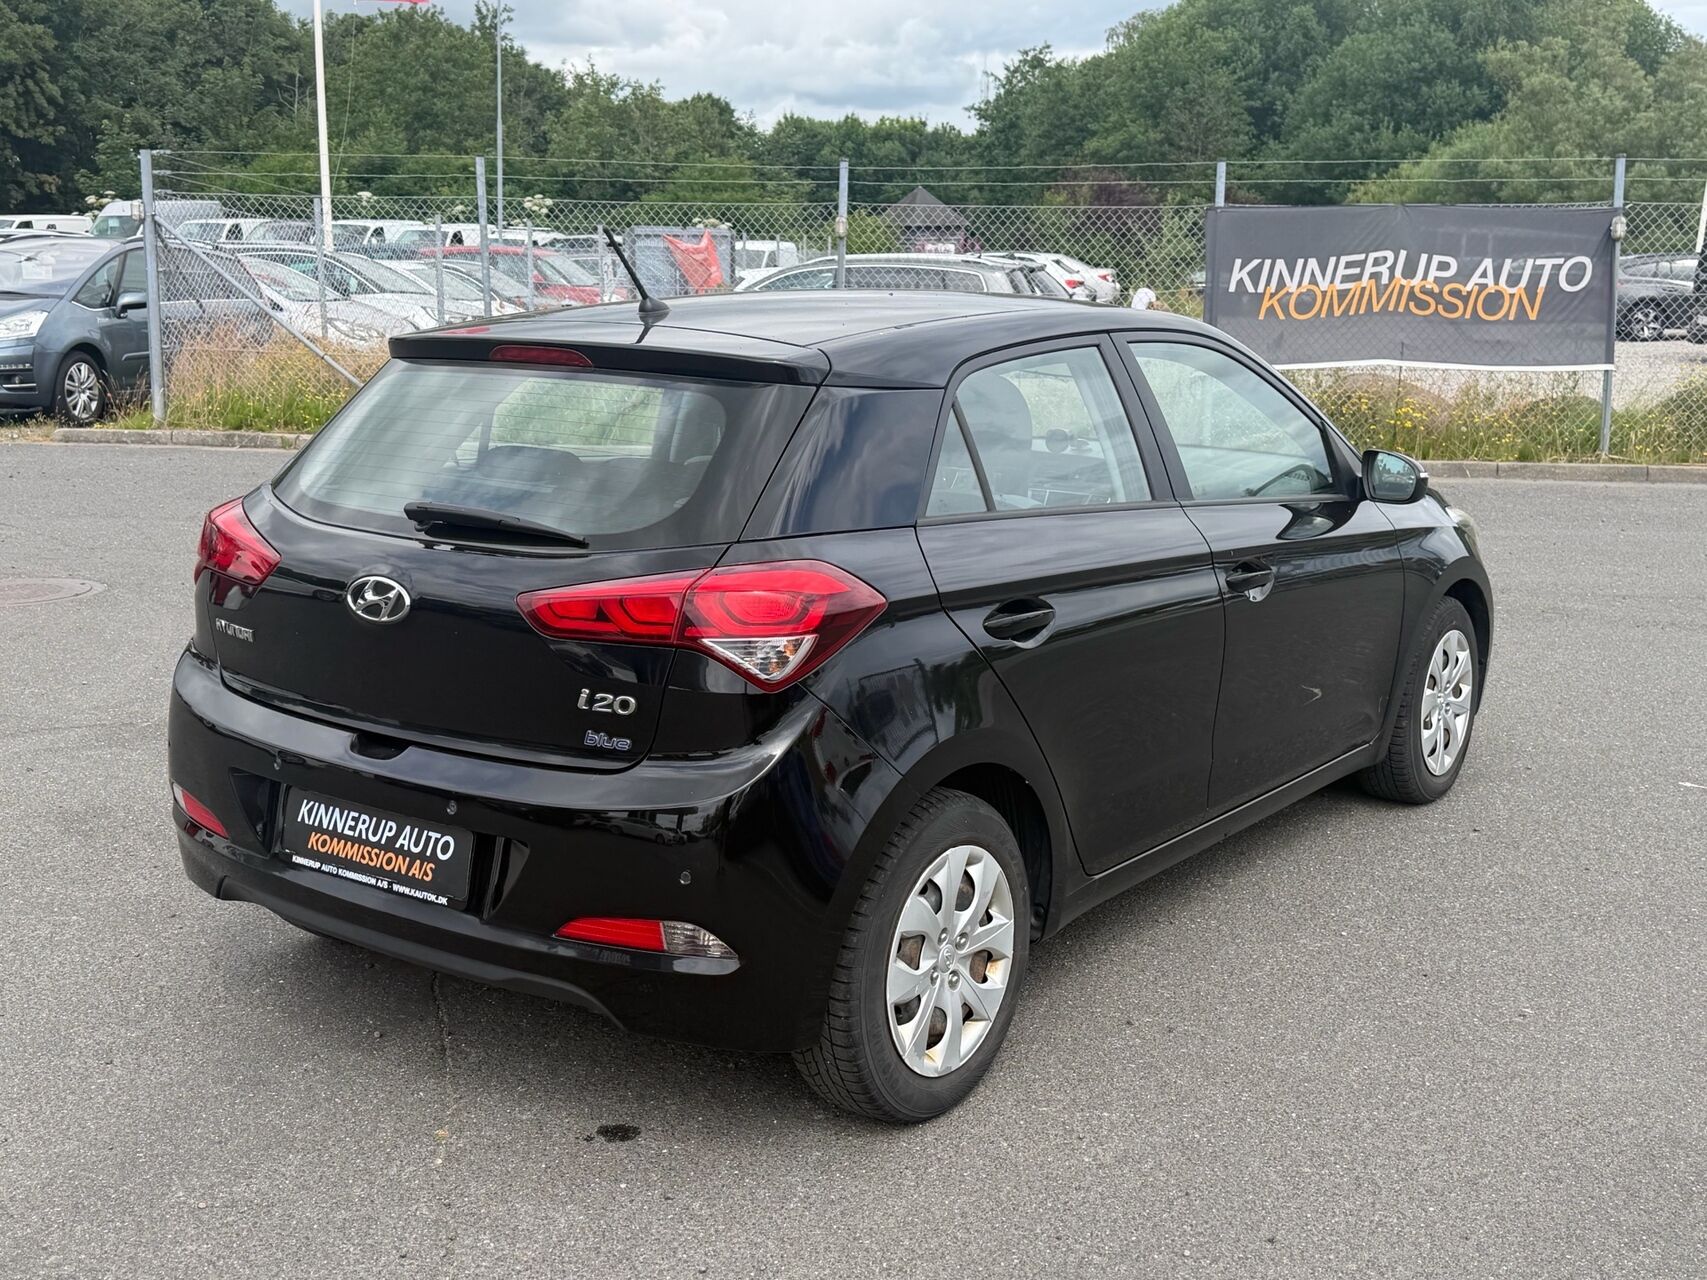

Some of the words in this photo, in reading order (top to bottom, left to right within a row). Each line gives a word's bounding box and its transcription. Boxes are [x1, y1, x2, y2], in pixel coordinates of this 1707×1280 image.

[1228, 249, 1458, 293] KINNERUP
[1465, 255, 1593, 294] AUTO
[1257, 276, 1545, 321] KOMMISSION
[577, 688, 636, 716] i20
[583, 729, 633, 751] blue
[297, 799, 396, 844] KINNERUP
[396, 825, 455, 861] AUTO
[292, 855, 321, 869] KINNERUP
[320, 863, 338, 875] AUTO
[337, 868, 377, 886] KOMMISSION
[376, 879, 389, 889] A/S
[308, 832, 409, 875] KOMMISSION
[408, 859, 436, 882] A/S
